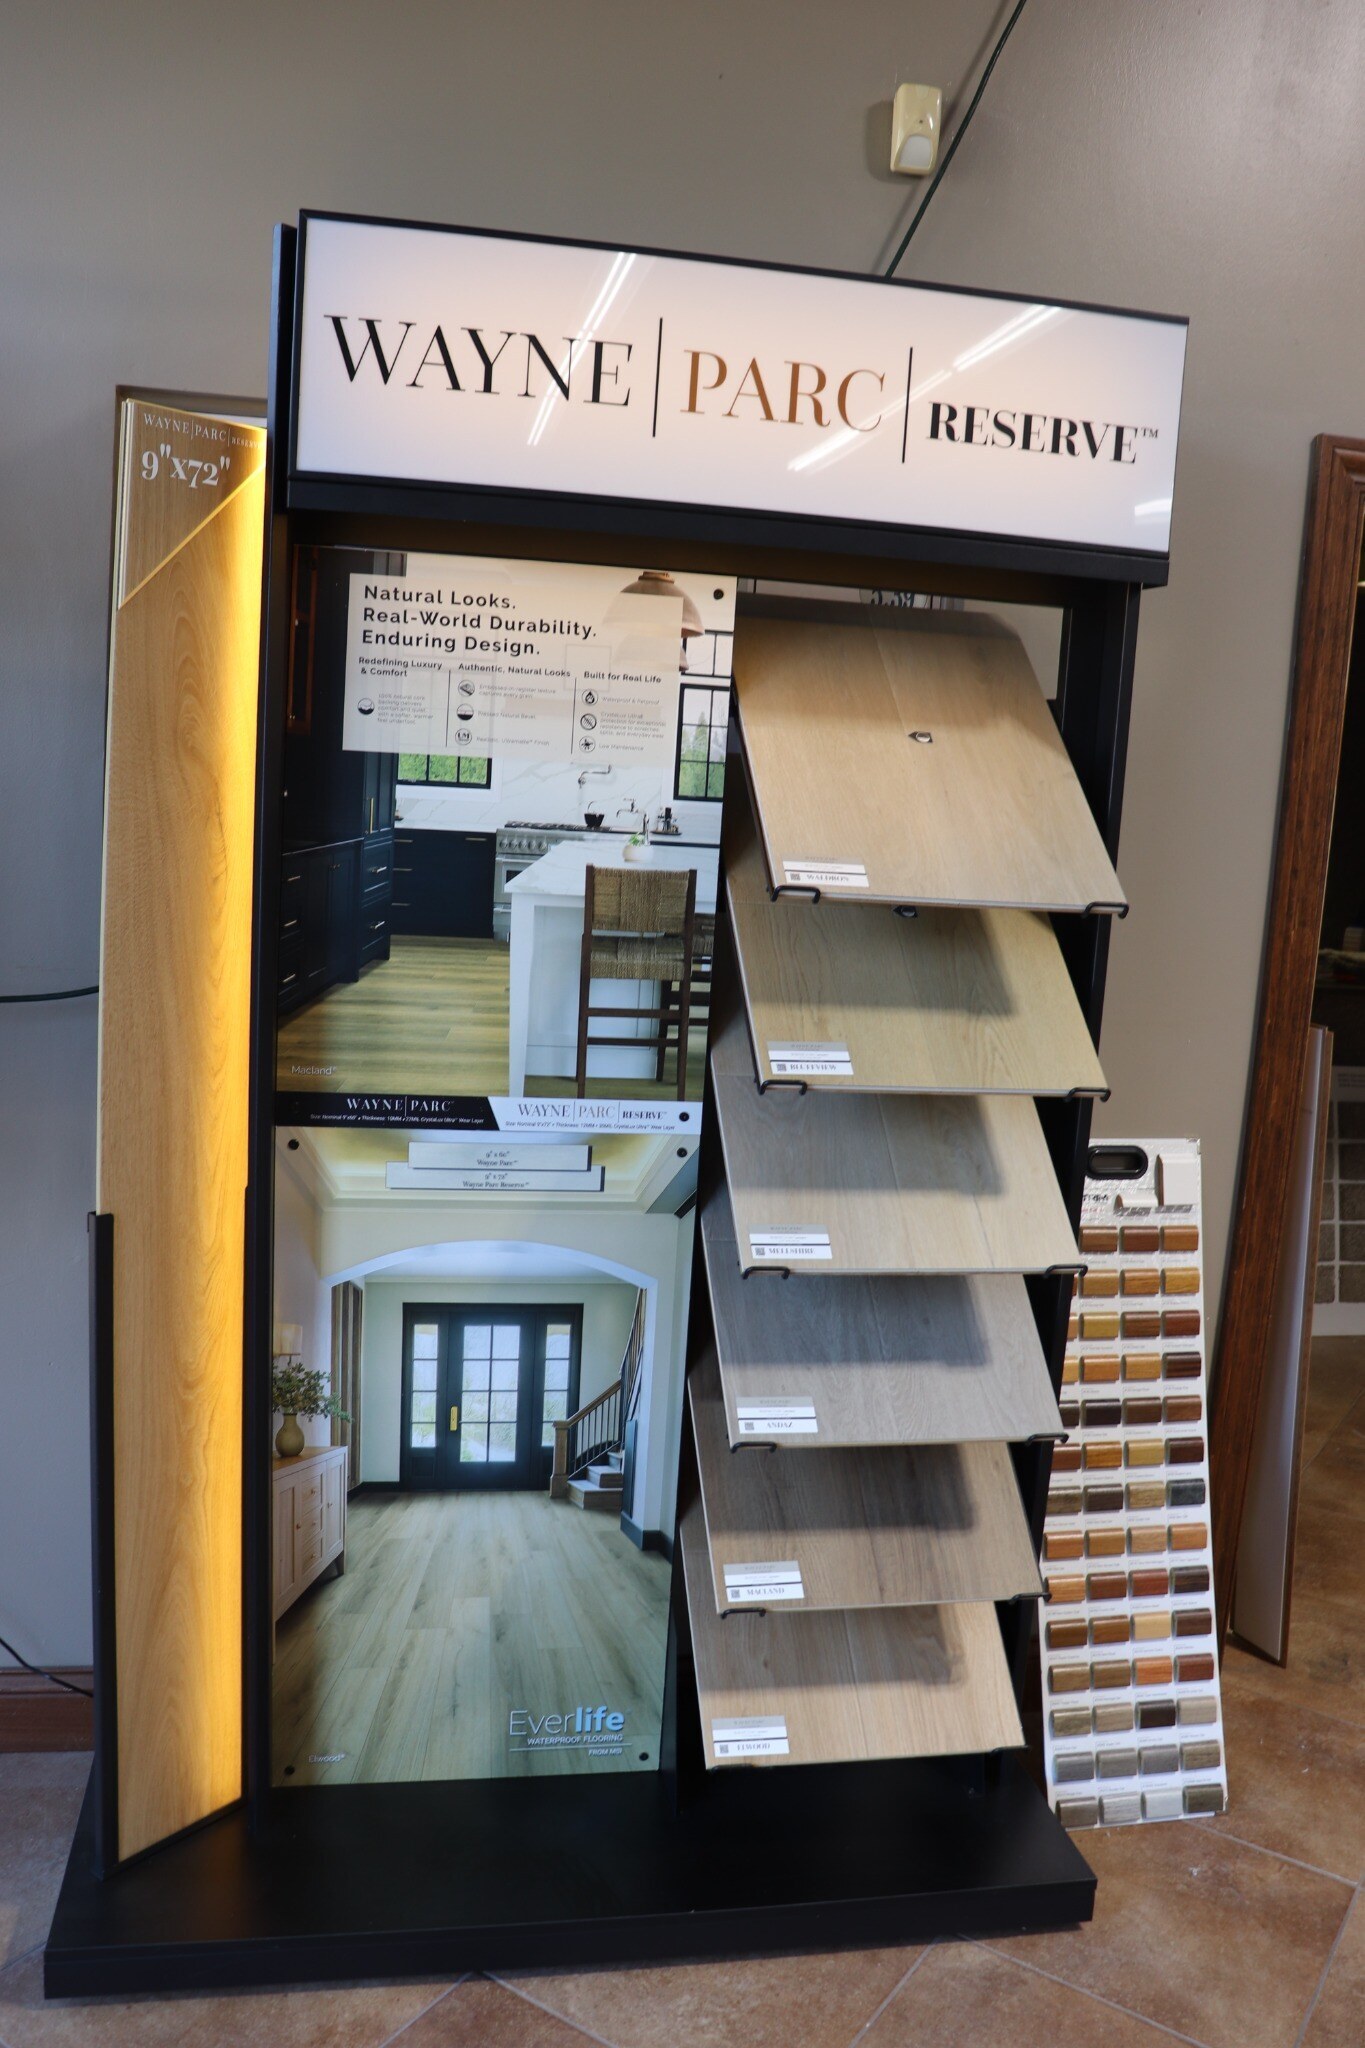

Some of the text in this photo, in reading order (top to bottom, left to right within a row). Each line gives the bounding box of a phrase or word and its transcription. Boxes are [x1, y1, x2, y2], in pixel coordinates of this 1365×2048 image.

[323, 314, 633, 406] WAYNE
[680, 349, 886, 432] PARC
[144, 412, 262, 449] WAYNE PARC RESERV
[364, 585, 516, 609] Natural Looks.
[363, 607, 597, 640] Real-World Durability.
[362, 630, 541, 658] Enduring Design.
[358, 657, 443, 671] Redefining Luxury
[459, 663, 571, 677] Authentic, Natural Looks
[370, 668, 408, 677] Comfort
[584, 671, 662, 683] Built for Real Life
[347, 1098, 403, 1111] WAYNE
[518, 1103, 571, 1118] WAYNE
[579, 1105, 616, 1119] PARC
[462, 1180, 483, 1189] Wayne
[509, 1704, 625, 1736] Everlife
[527, 1733, 623, 1746] WATERPROOF FLOORING
